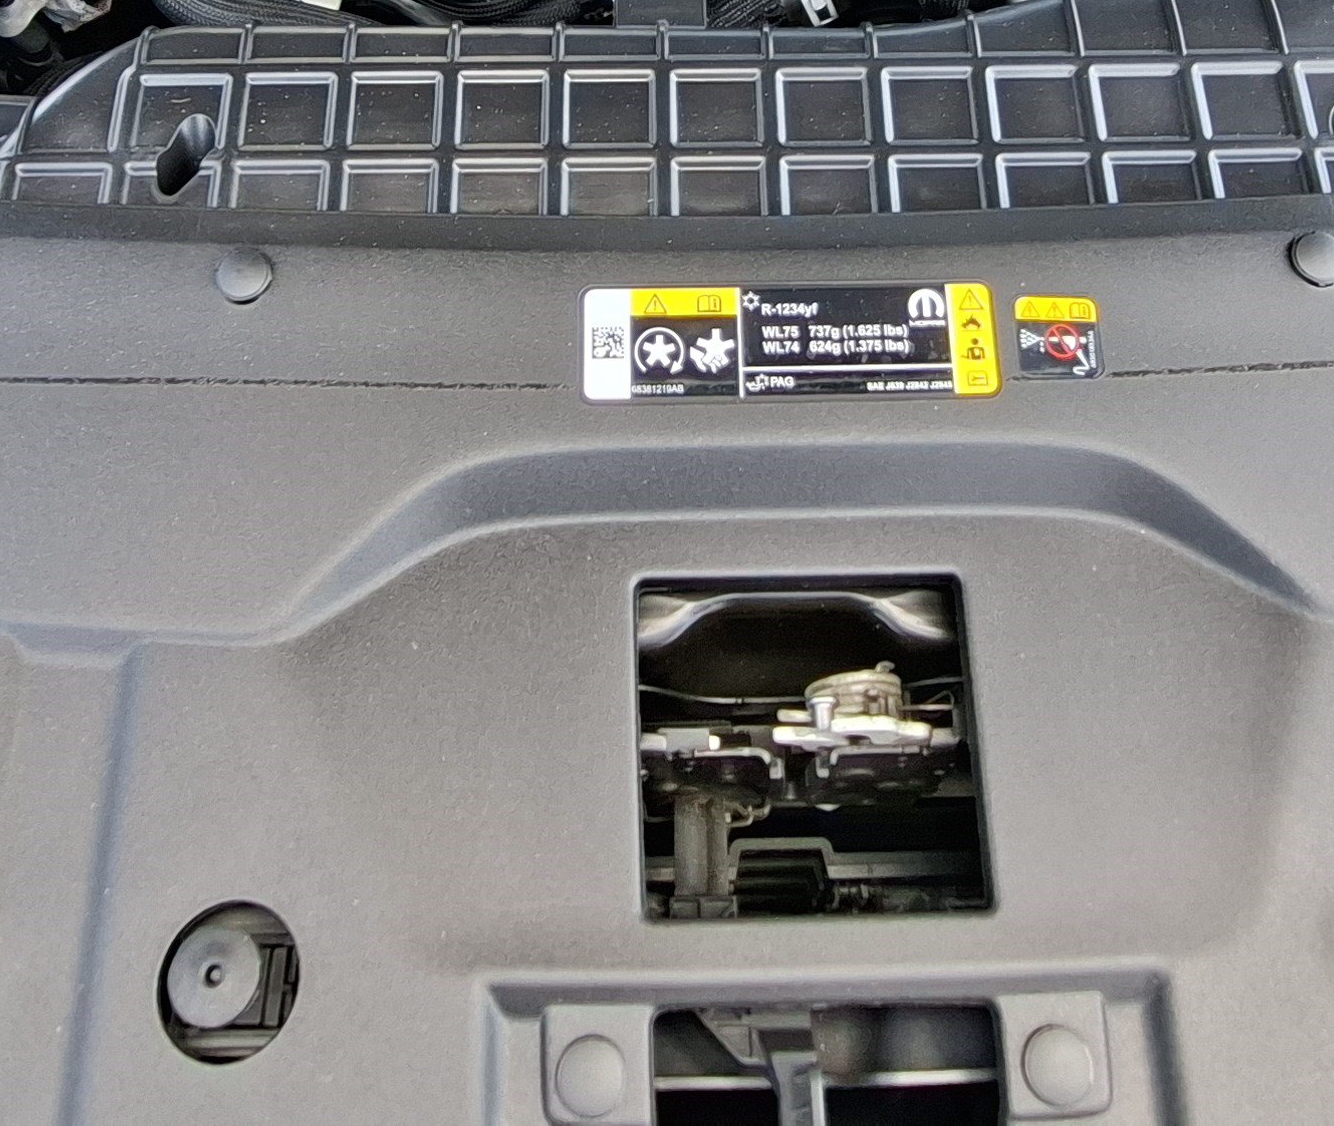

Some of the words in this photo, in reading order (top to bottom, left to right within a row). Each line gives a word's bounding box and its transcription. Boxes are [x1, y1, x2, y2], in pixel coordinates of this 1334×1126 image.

[761, 302, 818, 318] R-1234yf
[761, 325, 799, 339] WL75
[808, 324, 840, 340] 737g
[842, 324, 881, 340] (1.625
[883, 323, 909, 338] lbs)
[762, 341, 800, 355] WL74
[809, 340, 841, 356] 624g
[843, 339, 883, 355] (1.375
[884, 339, 909, 354] lbs)
[770, 375, 795, 389] PAG
